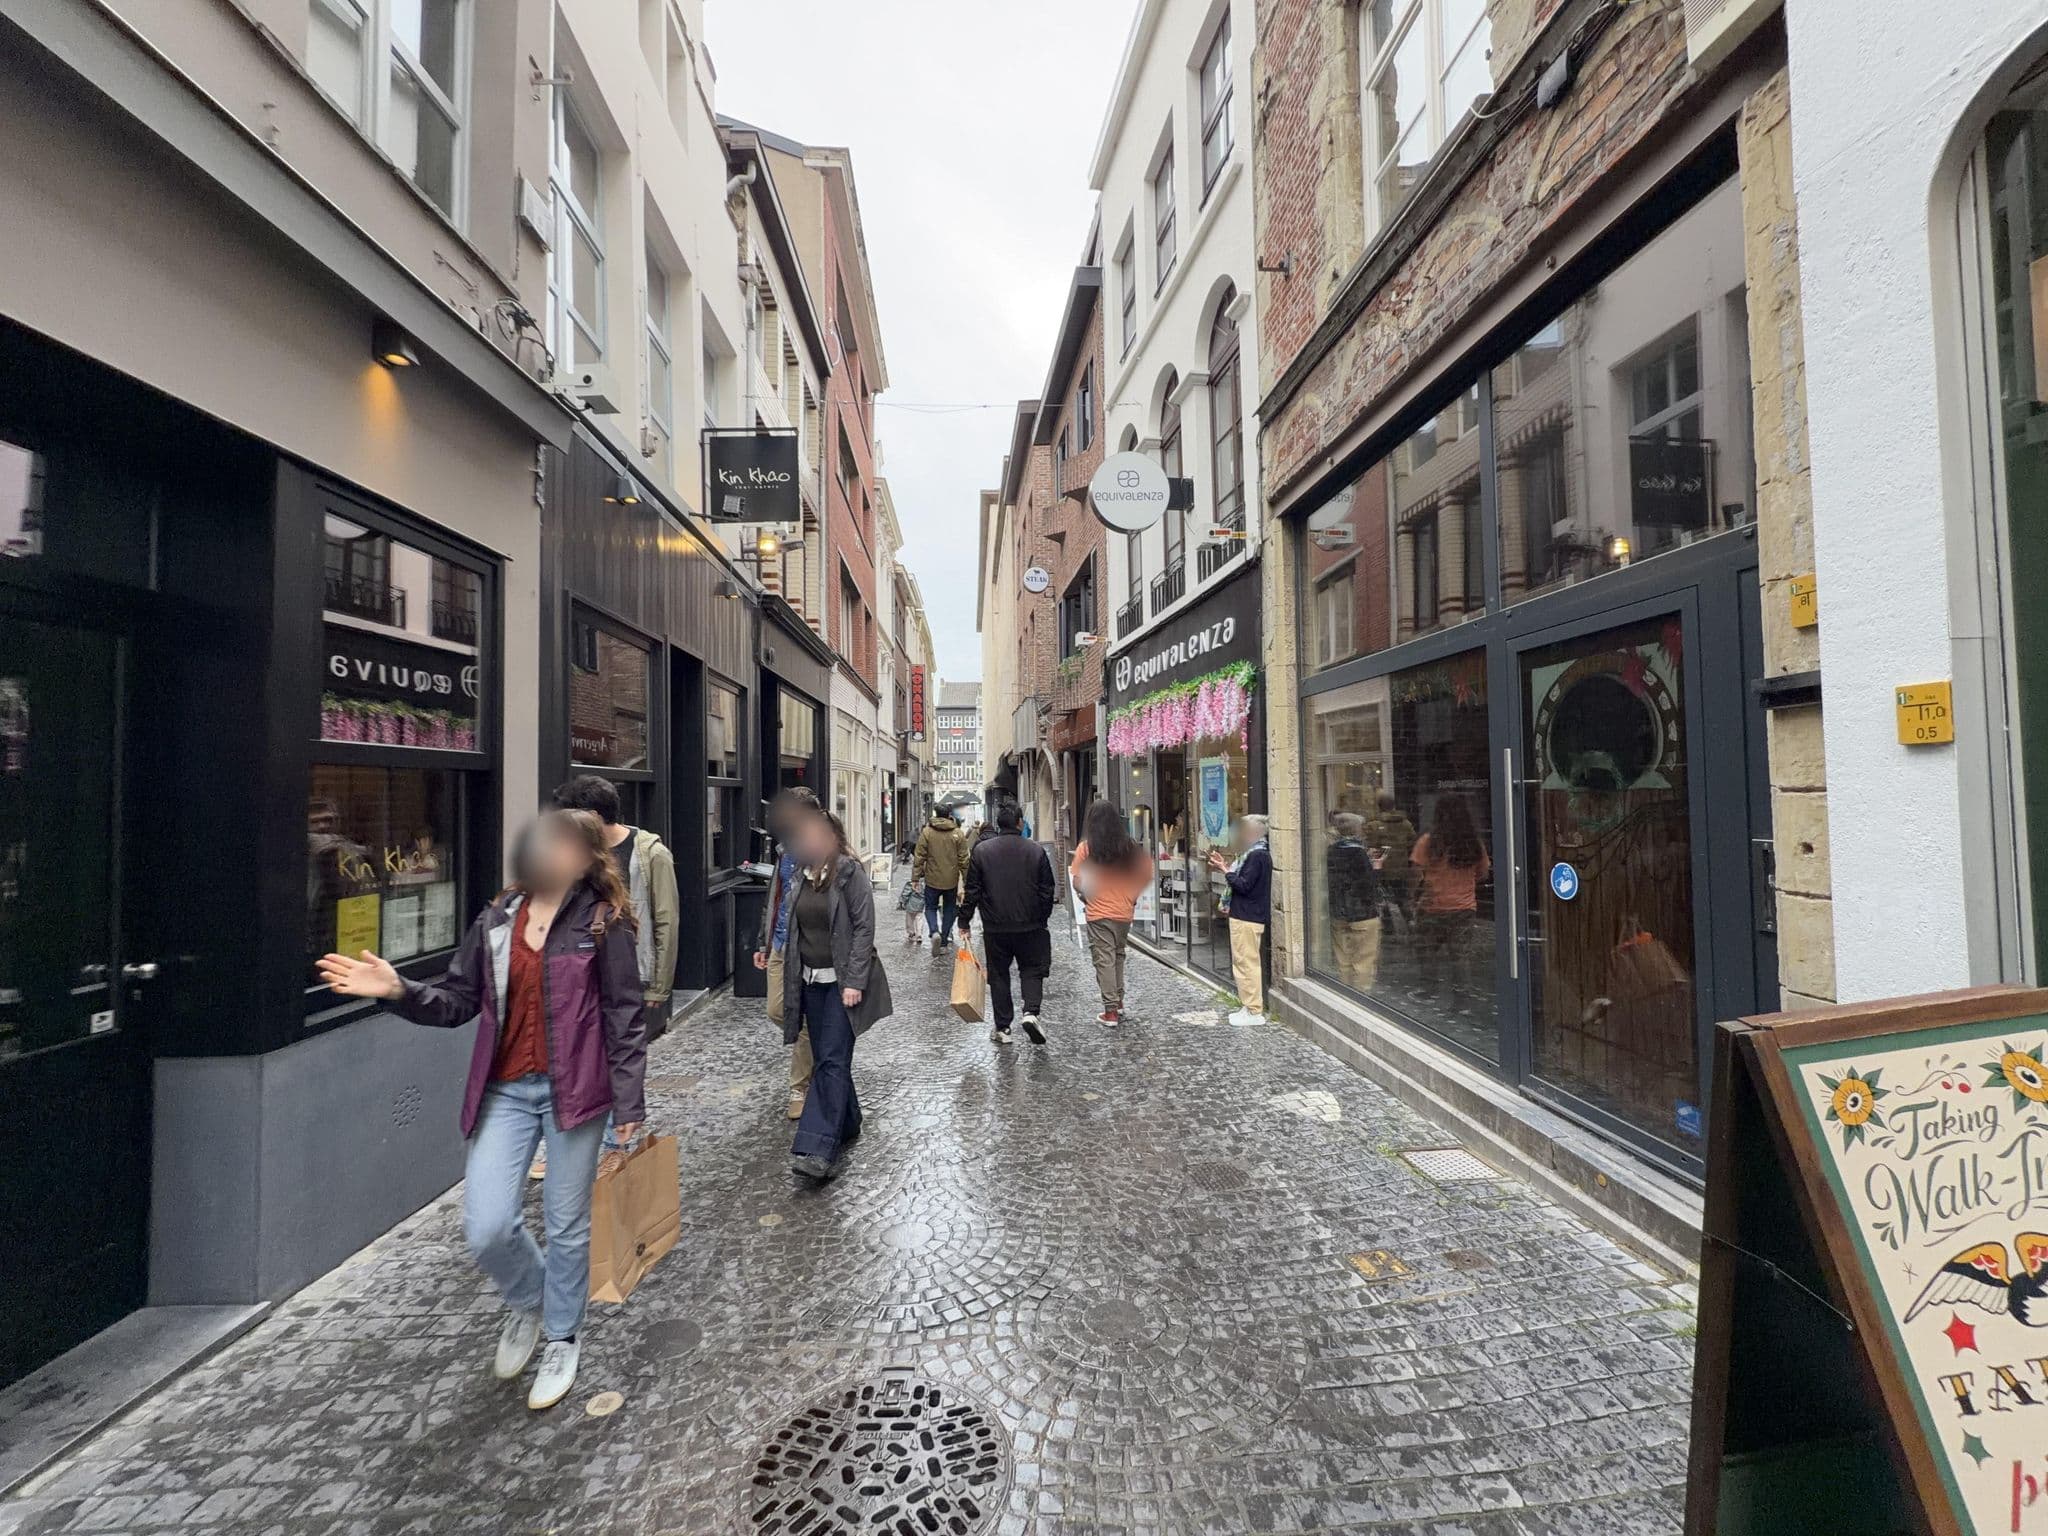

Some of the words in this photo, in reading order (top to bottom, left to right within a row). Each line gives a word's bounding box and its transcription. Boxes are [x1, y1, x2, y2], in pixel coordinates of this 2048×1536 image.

[719, 468, 744, 485] Kin
[748, 466, 790, 485] Khao
[337, 851, 376, 882] Kin
[1889, 1096, 2005, 1161] Taking
